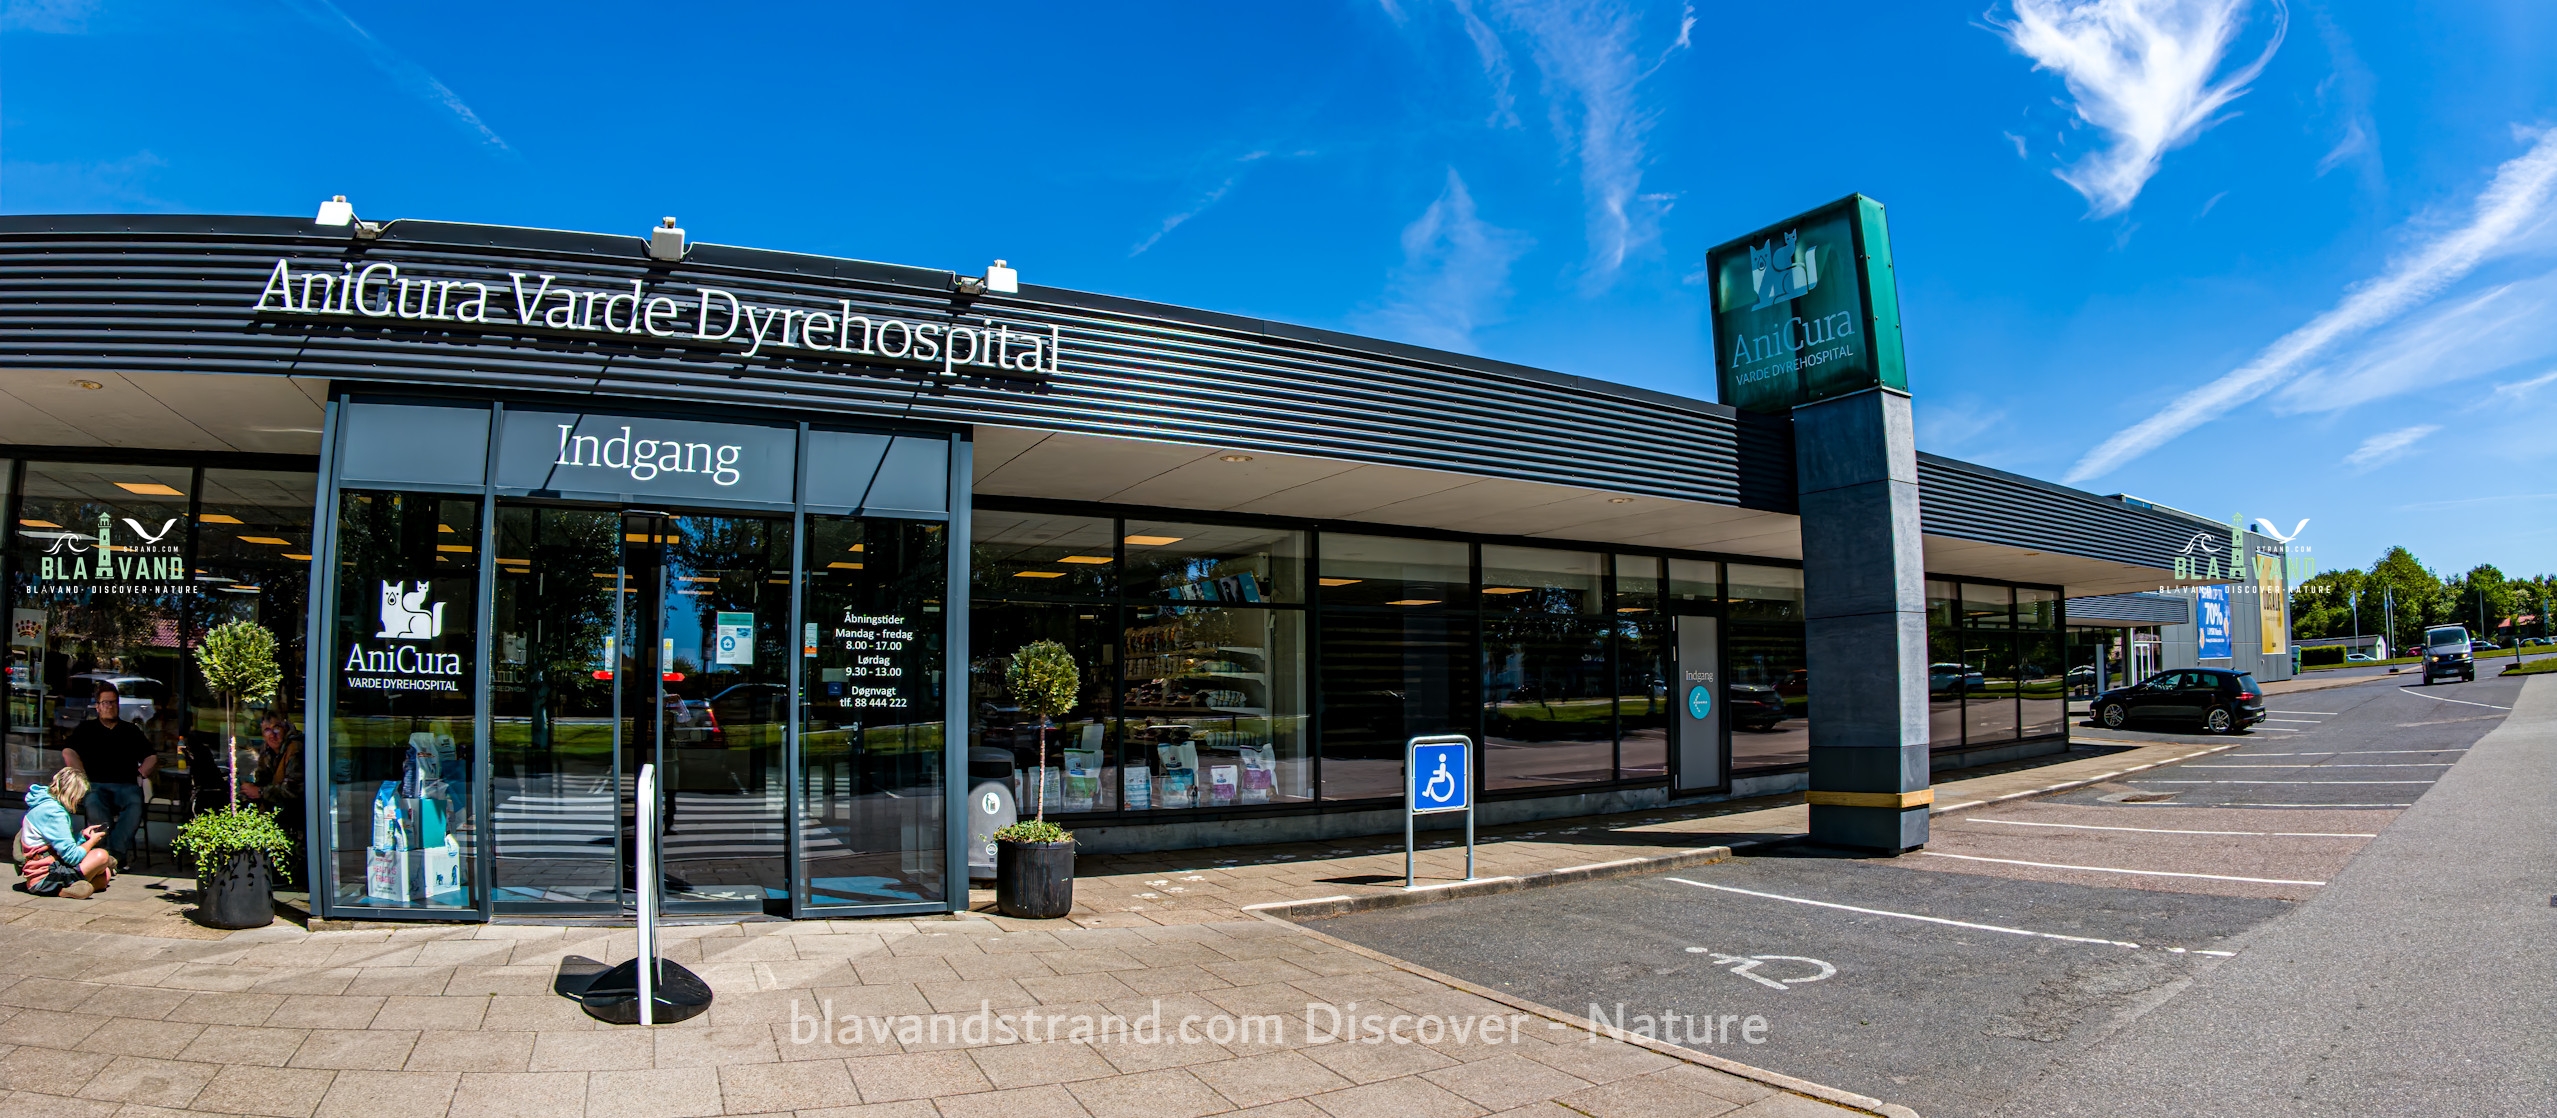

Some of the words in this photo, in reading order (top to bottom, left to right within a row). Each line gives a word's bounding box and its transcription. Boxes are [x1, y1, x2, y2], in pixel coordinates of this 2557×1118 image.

[252, 258, 488, 323] AniCura
[508, 272, 677, 337] Varde
[691, 288, 1060, 376] Dyrehospital
[1731, 310, 1856, 369] AniCura
[1735, 366, 1770, 386] VARDE
[1772, 344, 1854, 378] DYREHOSPITAL
[554, 424, 742, 486] Indgang
[844, 611, 905, 625] Åbningstider
[2204, 602, 2223, 625] 70%
[835, 628, 874, 640] Mandag
[881, 629, 913, 641] fredag
[846, 641, 867, 650] 8.00
[875, 641, 902, 650] 17.00
[344, 643, 462, 675] AniCura
[858, 655, 890, 666] Lørdag
[845, 667, 867, 677] 9.30
[875, 667, 902, 677] 13.00
[1685, 669, 1714, 683] Indgang
[348, 677, 382, 689] VARDE
[383, 678, 459, 691] DYREHOSPITAL
[851, 686, 897, 697] Døgnvagt
[839, 697, 853, 708] tlf.
[854, 698, 867, 708] 88
[868, 698, 887, 708] 444
[889, 698, 907, 708] 222
